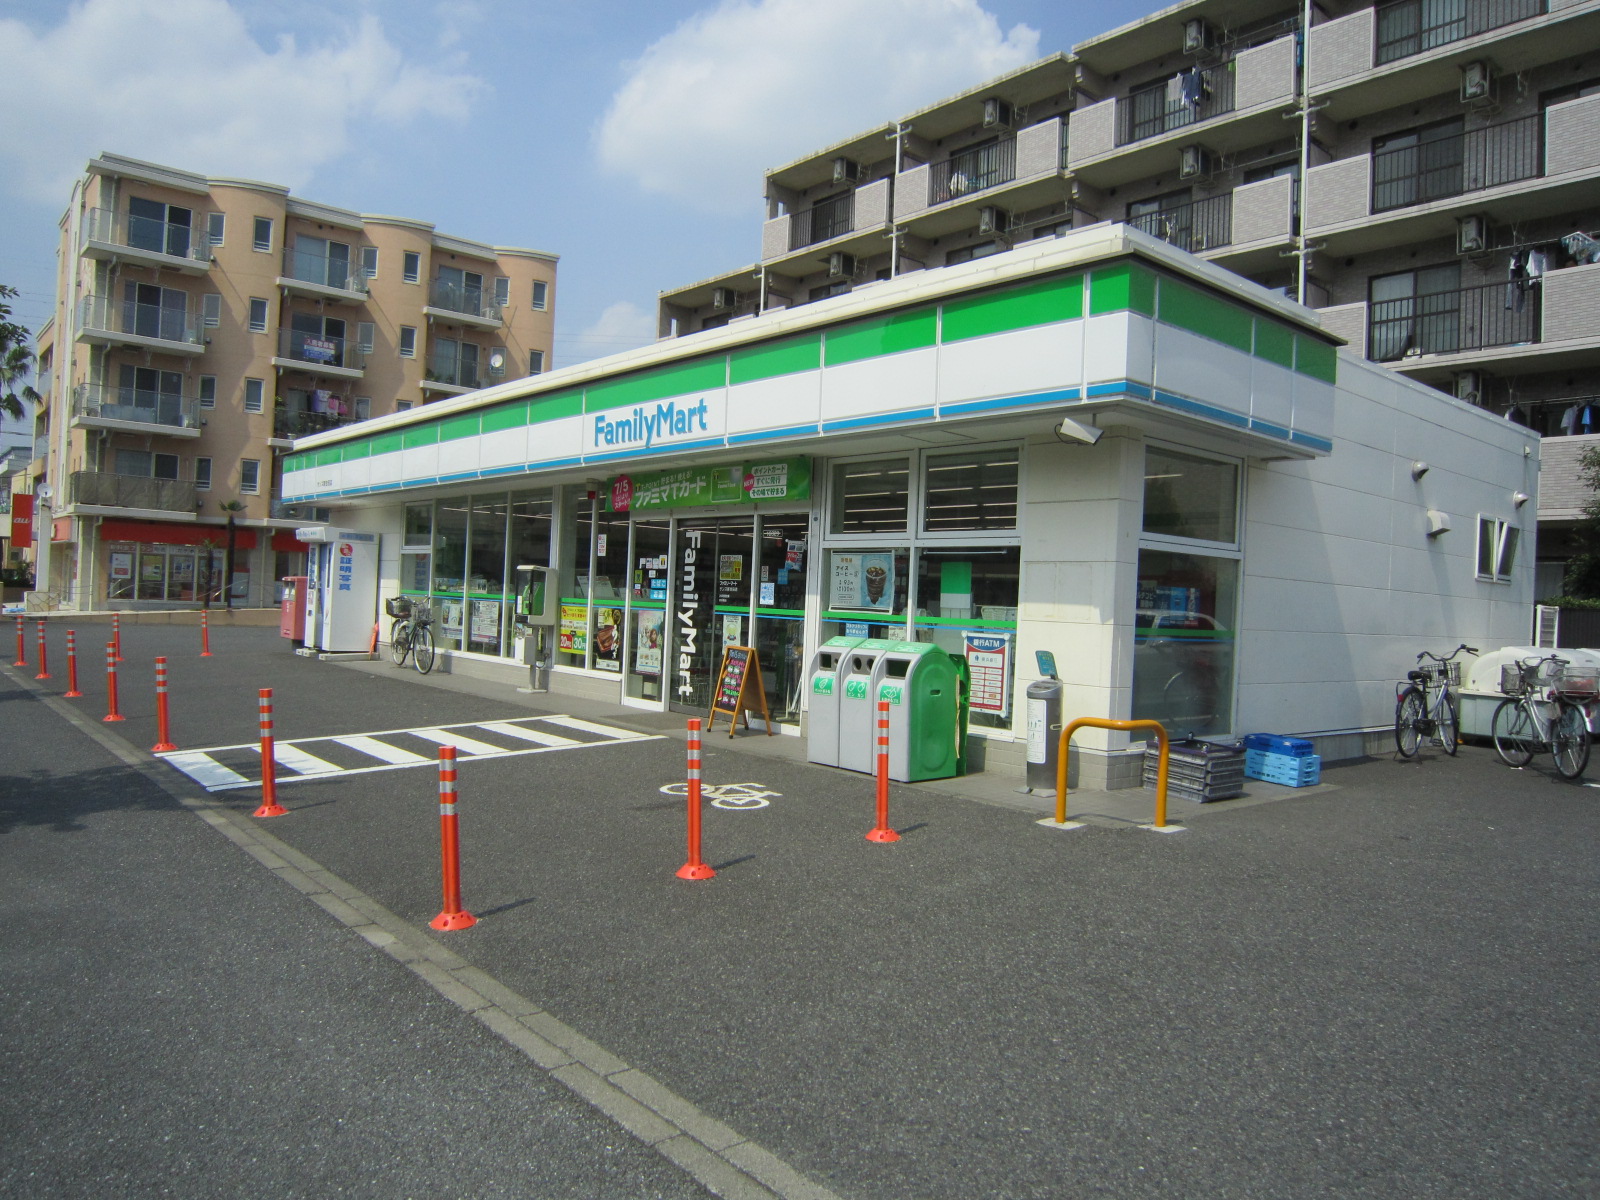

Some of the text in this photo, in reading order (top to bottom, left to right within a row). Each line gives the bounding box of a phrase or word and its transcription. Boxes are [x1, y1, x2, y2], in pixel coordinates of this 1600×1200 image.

[594, 398, 708, 447] FamilyMart
[754, 465, 786, 475] ポイントカード
[743, 479, 754, 488] NEW
[756, 476, 781, 485] すぐに発行
[614, 480, 629, 495] 7/5
[635, 475, 707, 508] ファミマTカード
[751, 487, 785, 497] その場で貯まる
[338, 556, 353, 591] 証明写真
[678, 531, 701, 697] FamilyMart
[973, 638, 1000, 648] 銀行ATM
